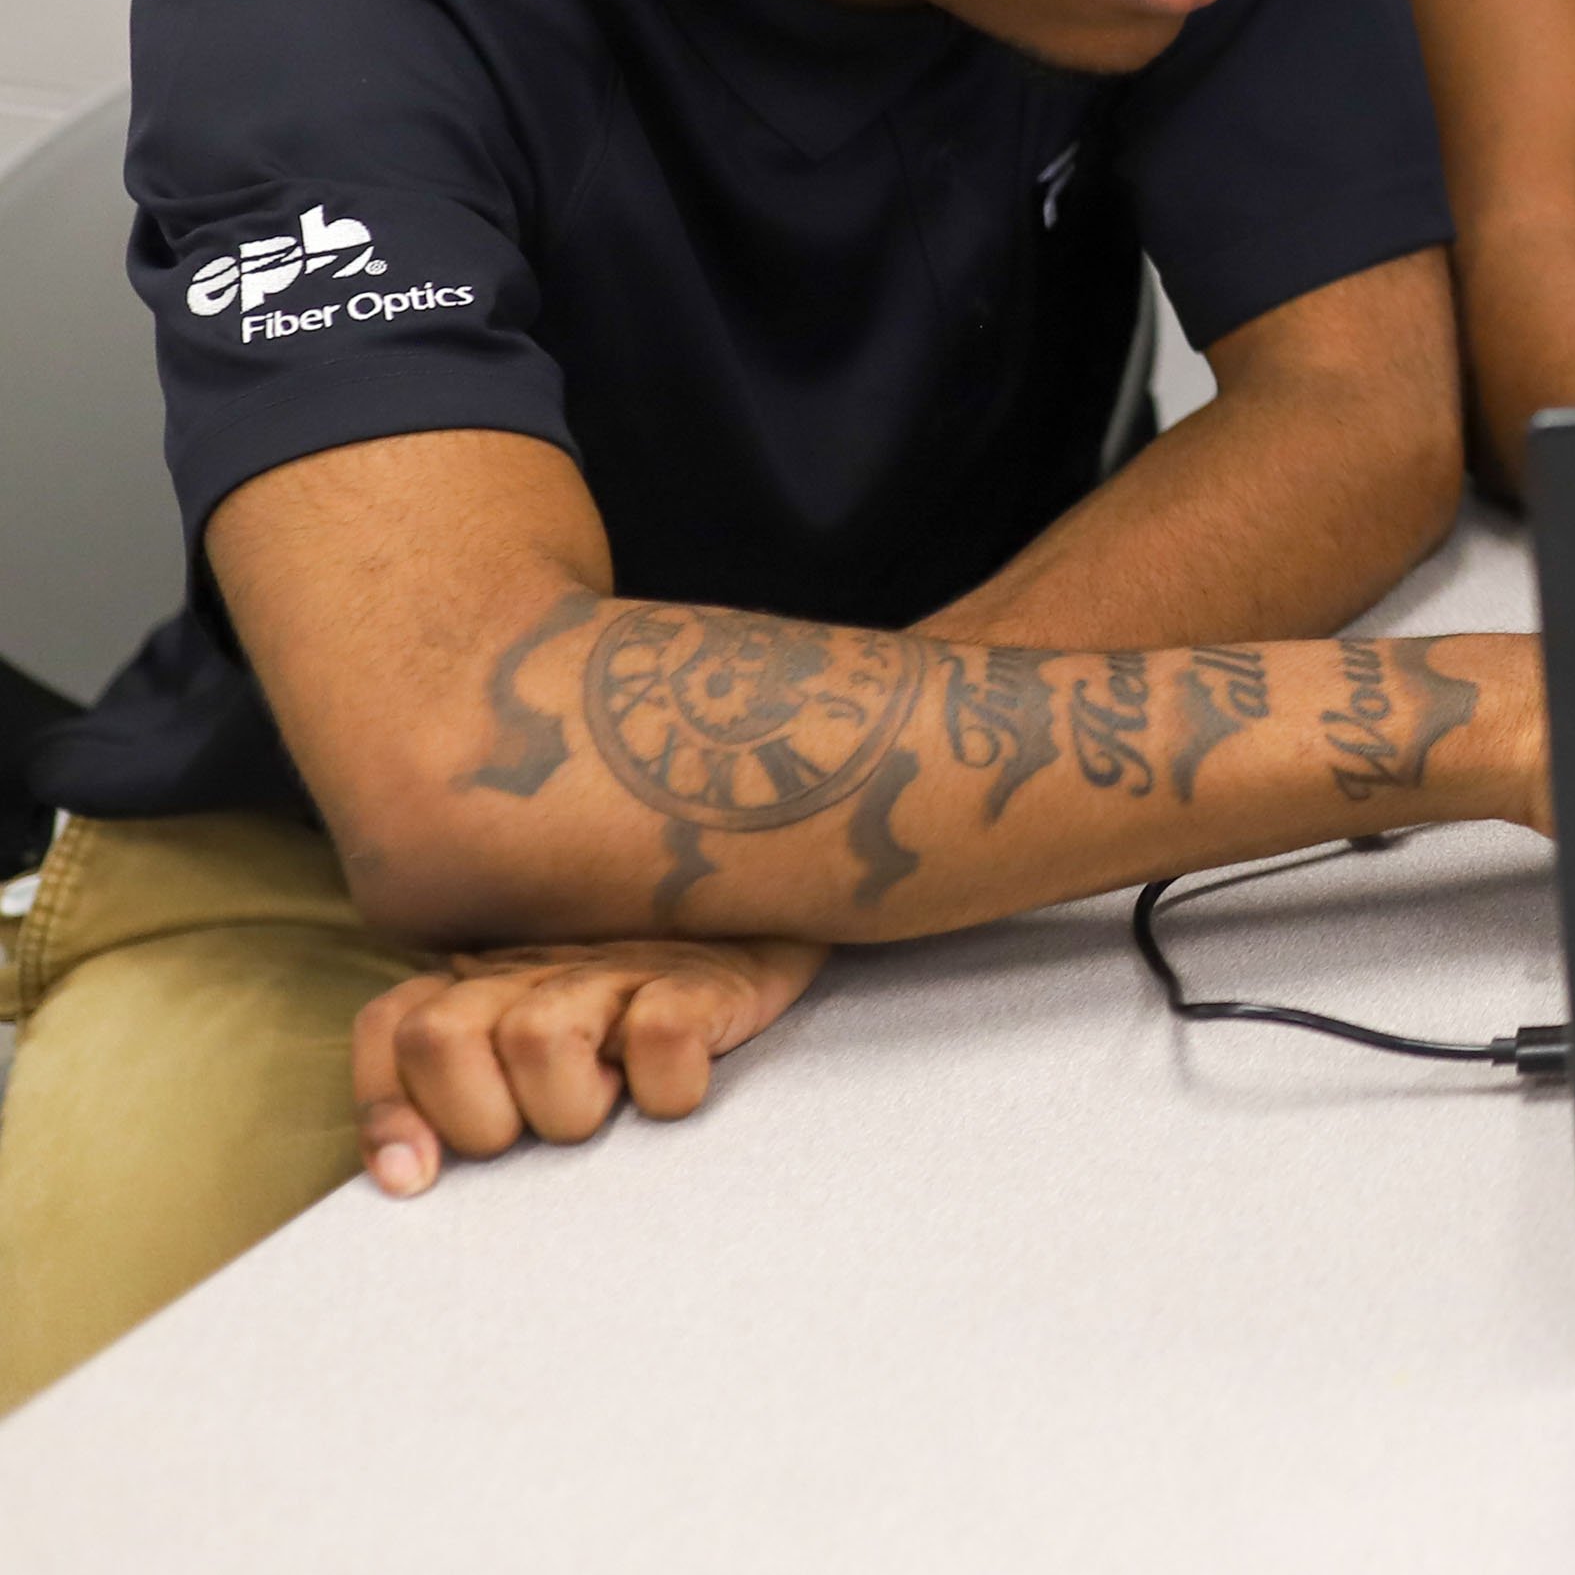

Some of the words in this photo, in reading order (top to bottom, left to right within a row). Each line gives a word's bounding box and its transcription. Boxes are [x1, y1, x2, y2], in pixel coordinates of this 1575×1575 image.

[241, 303, 342, 344] Fiber
[345, 281, 475, 322] Optics
[1192, 646, 1270, 719] all
